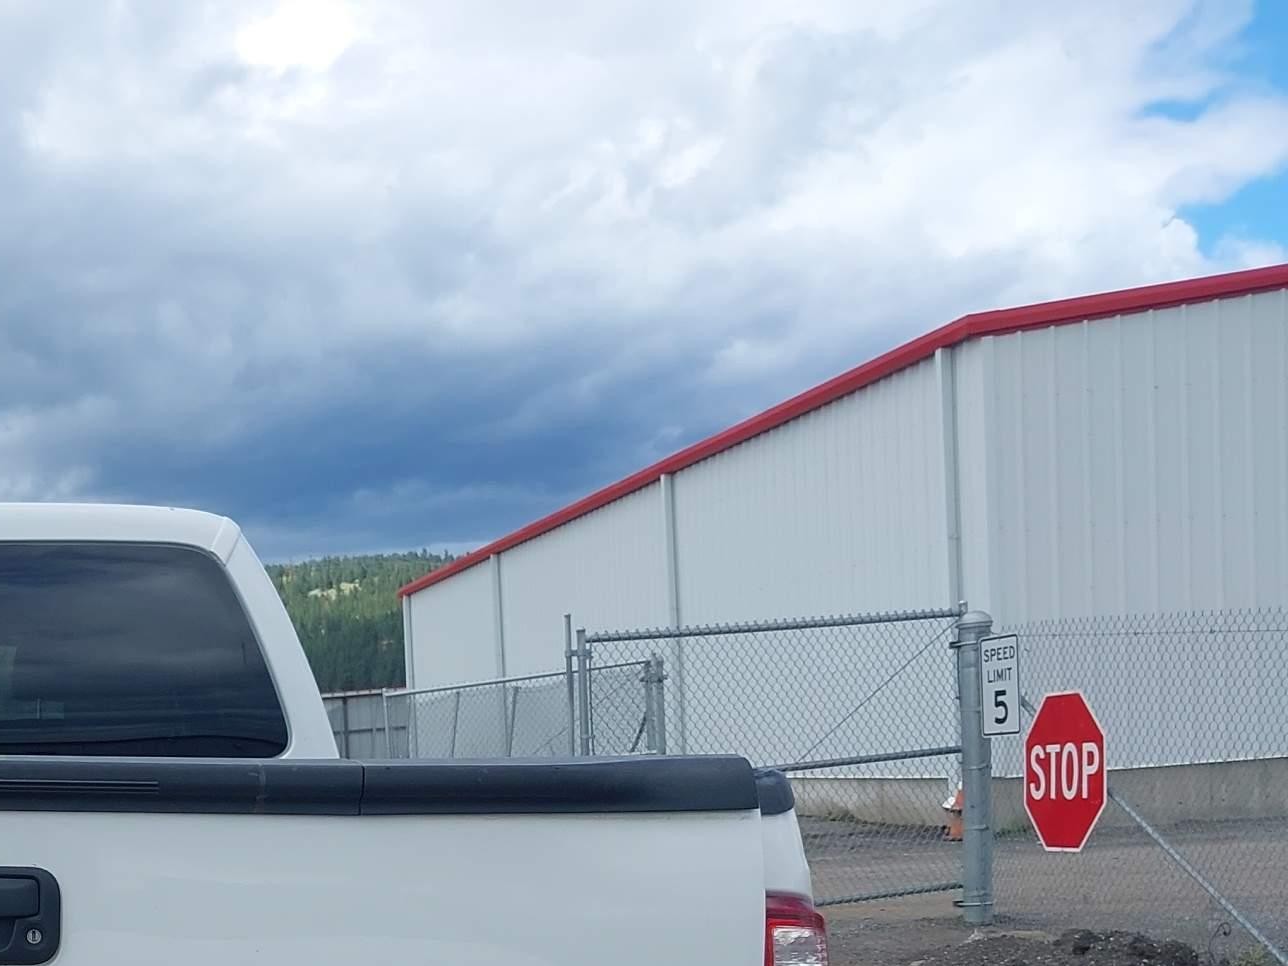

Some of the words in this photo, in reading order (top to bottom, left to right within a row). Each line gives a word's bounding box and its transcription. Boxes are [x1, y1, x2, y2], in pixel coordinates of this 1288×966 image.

[983, 645, 1015, 663] SPEED
[987, 667, 1012, 683] LIMIT
[994, 689, 1009, 725] 5
[1029, 742, 1100, 801] STOP
